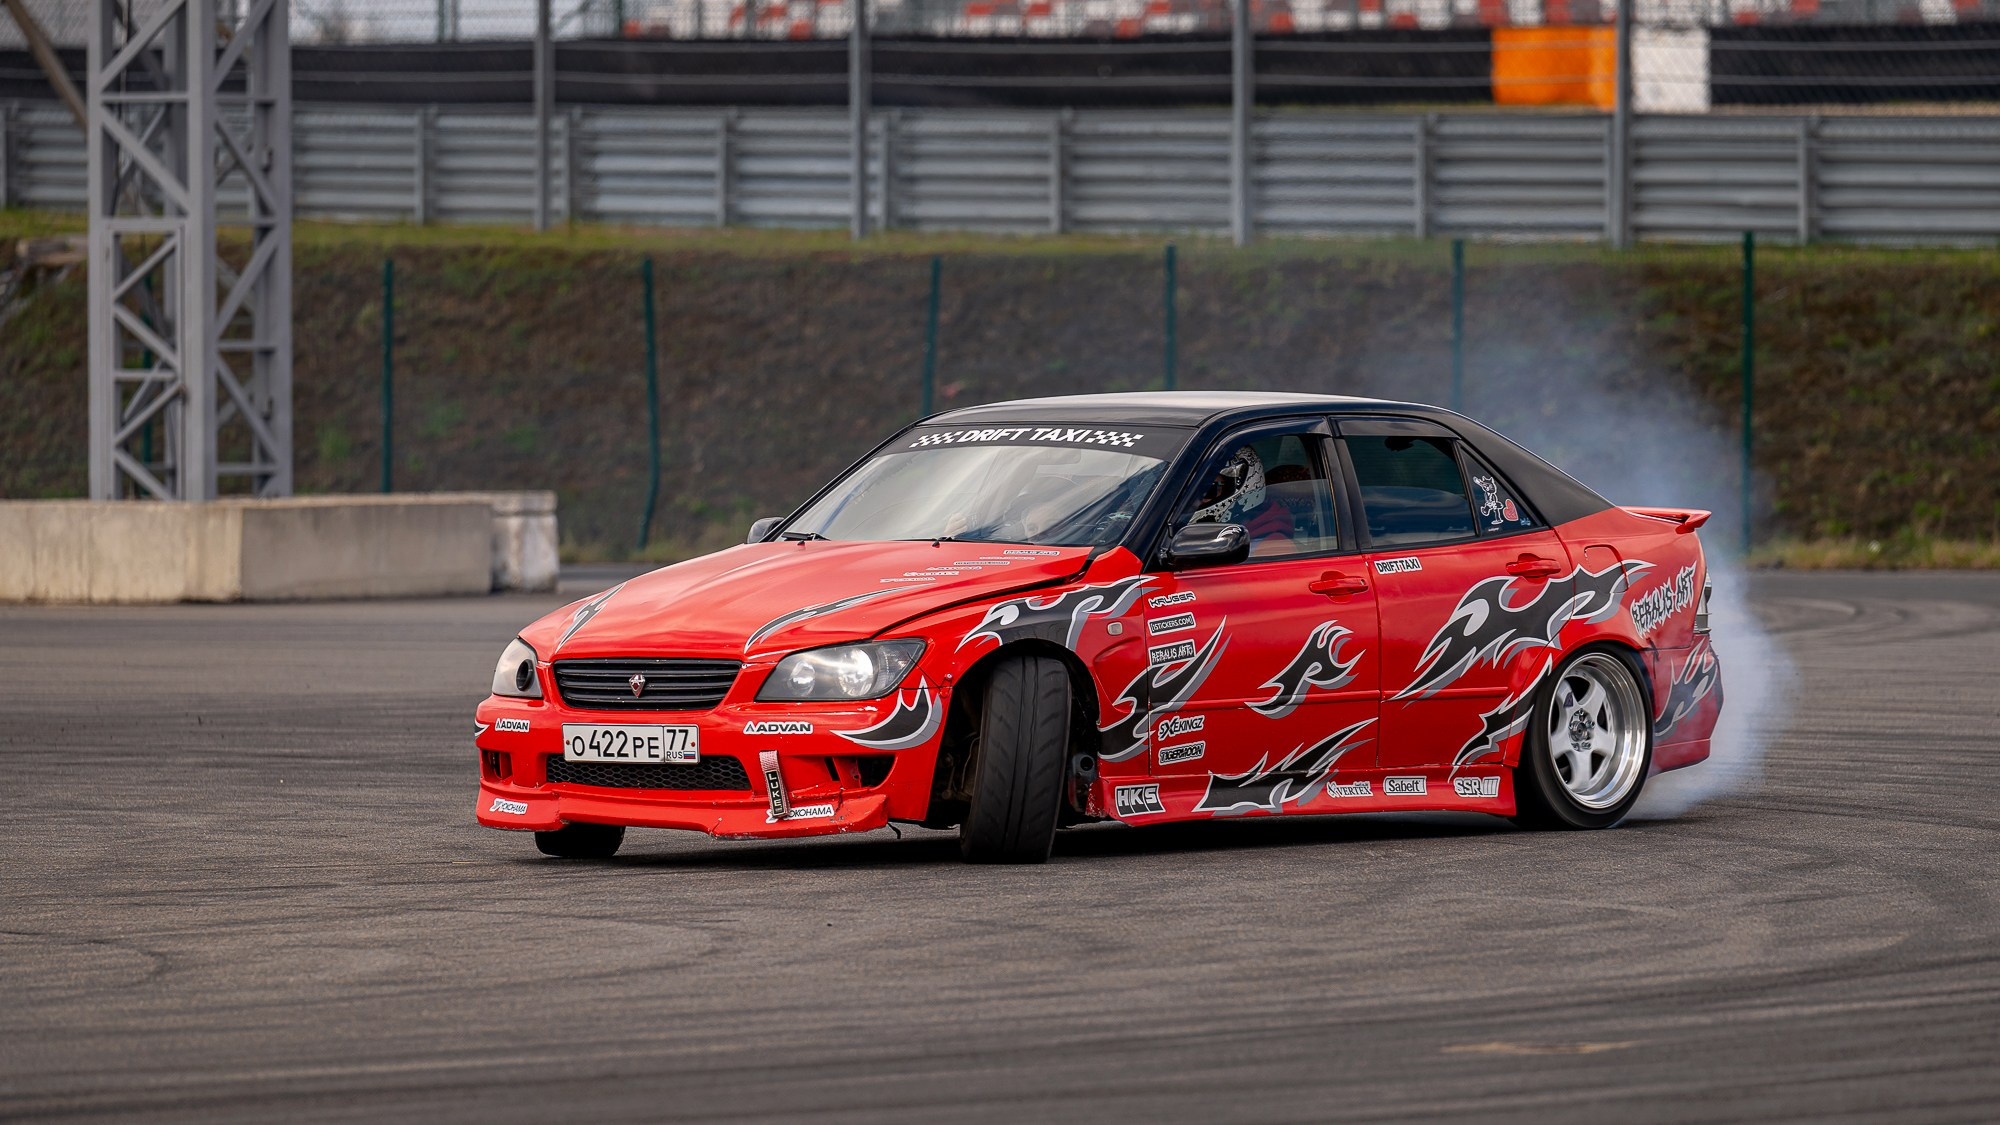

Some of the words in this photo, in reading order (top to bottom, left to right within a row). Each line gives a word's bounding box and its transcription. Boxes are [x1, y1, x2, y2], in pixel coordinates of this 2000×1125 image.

[957, 428, 1033, 443] DRIFT
[1029, 428, 1093, 443] TAXI
[1376, 560, 1400, 573] DRIFT
[1399, 558, 1421, 571] TAXI
[1675, 562, 1697, 609] ART
[1150, 593, 1195, 607] KRUGER
[500, 721, 529, 731] ADVAN
[756, 723, 812, 732] ADVAN
[666, 729, 690, 751] 77
[666, 751, 683, 760] RUS
[768, 773, 783, 807] LUKE
[1336, 786, 1372, 796] VERTEX
[1388, 779, 1421, 792] Sabelt
[1117, 786, 1158, 807] HKS
